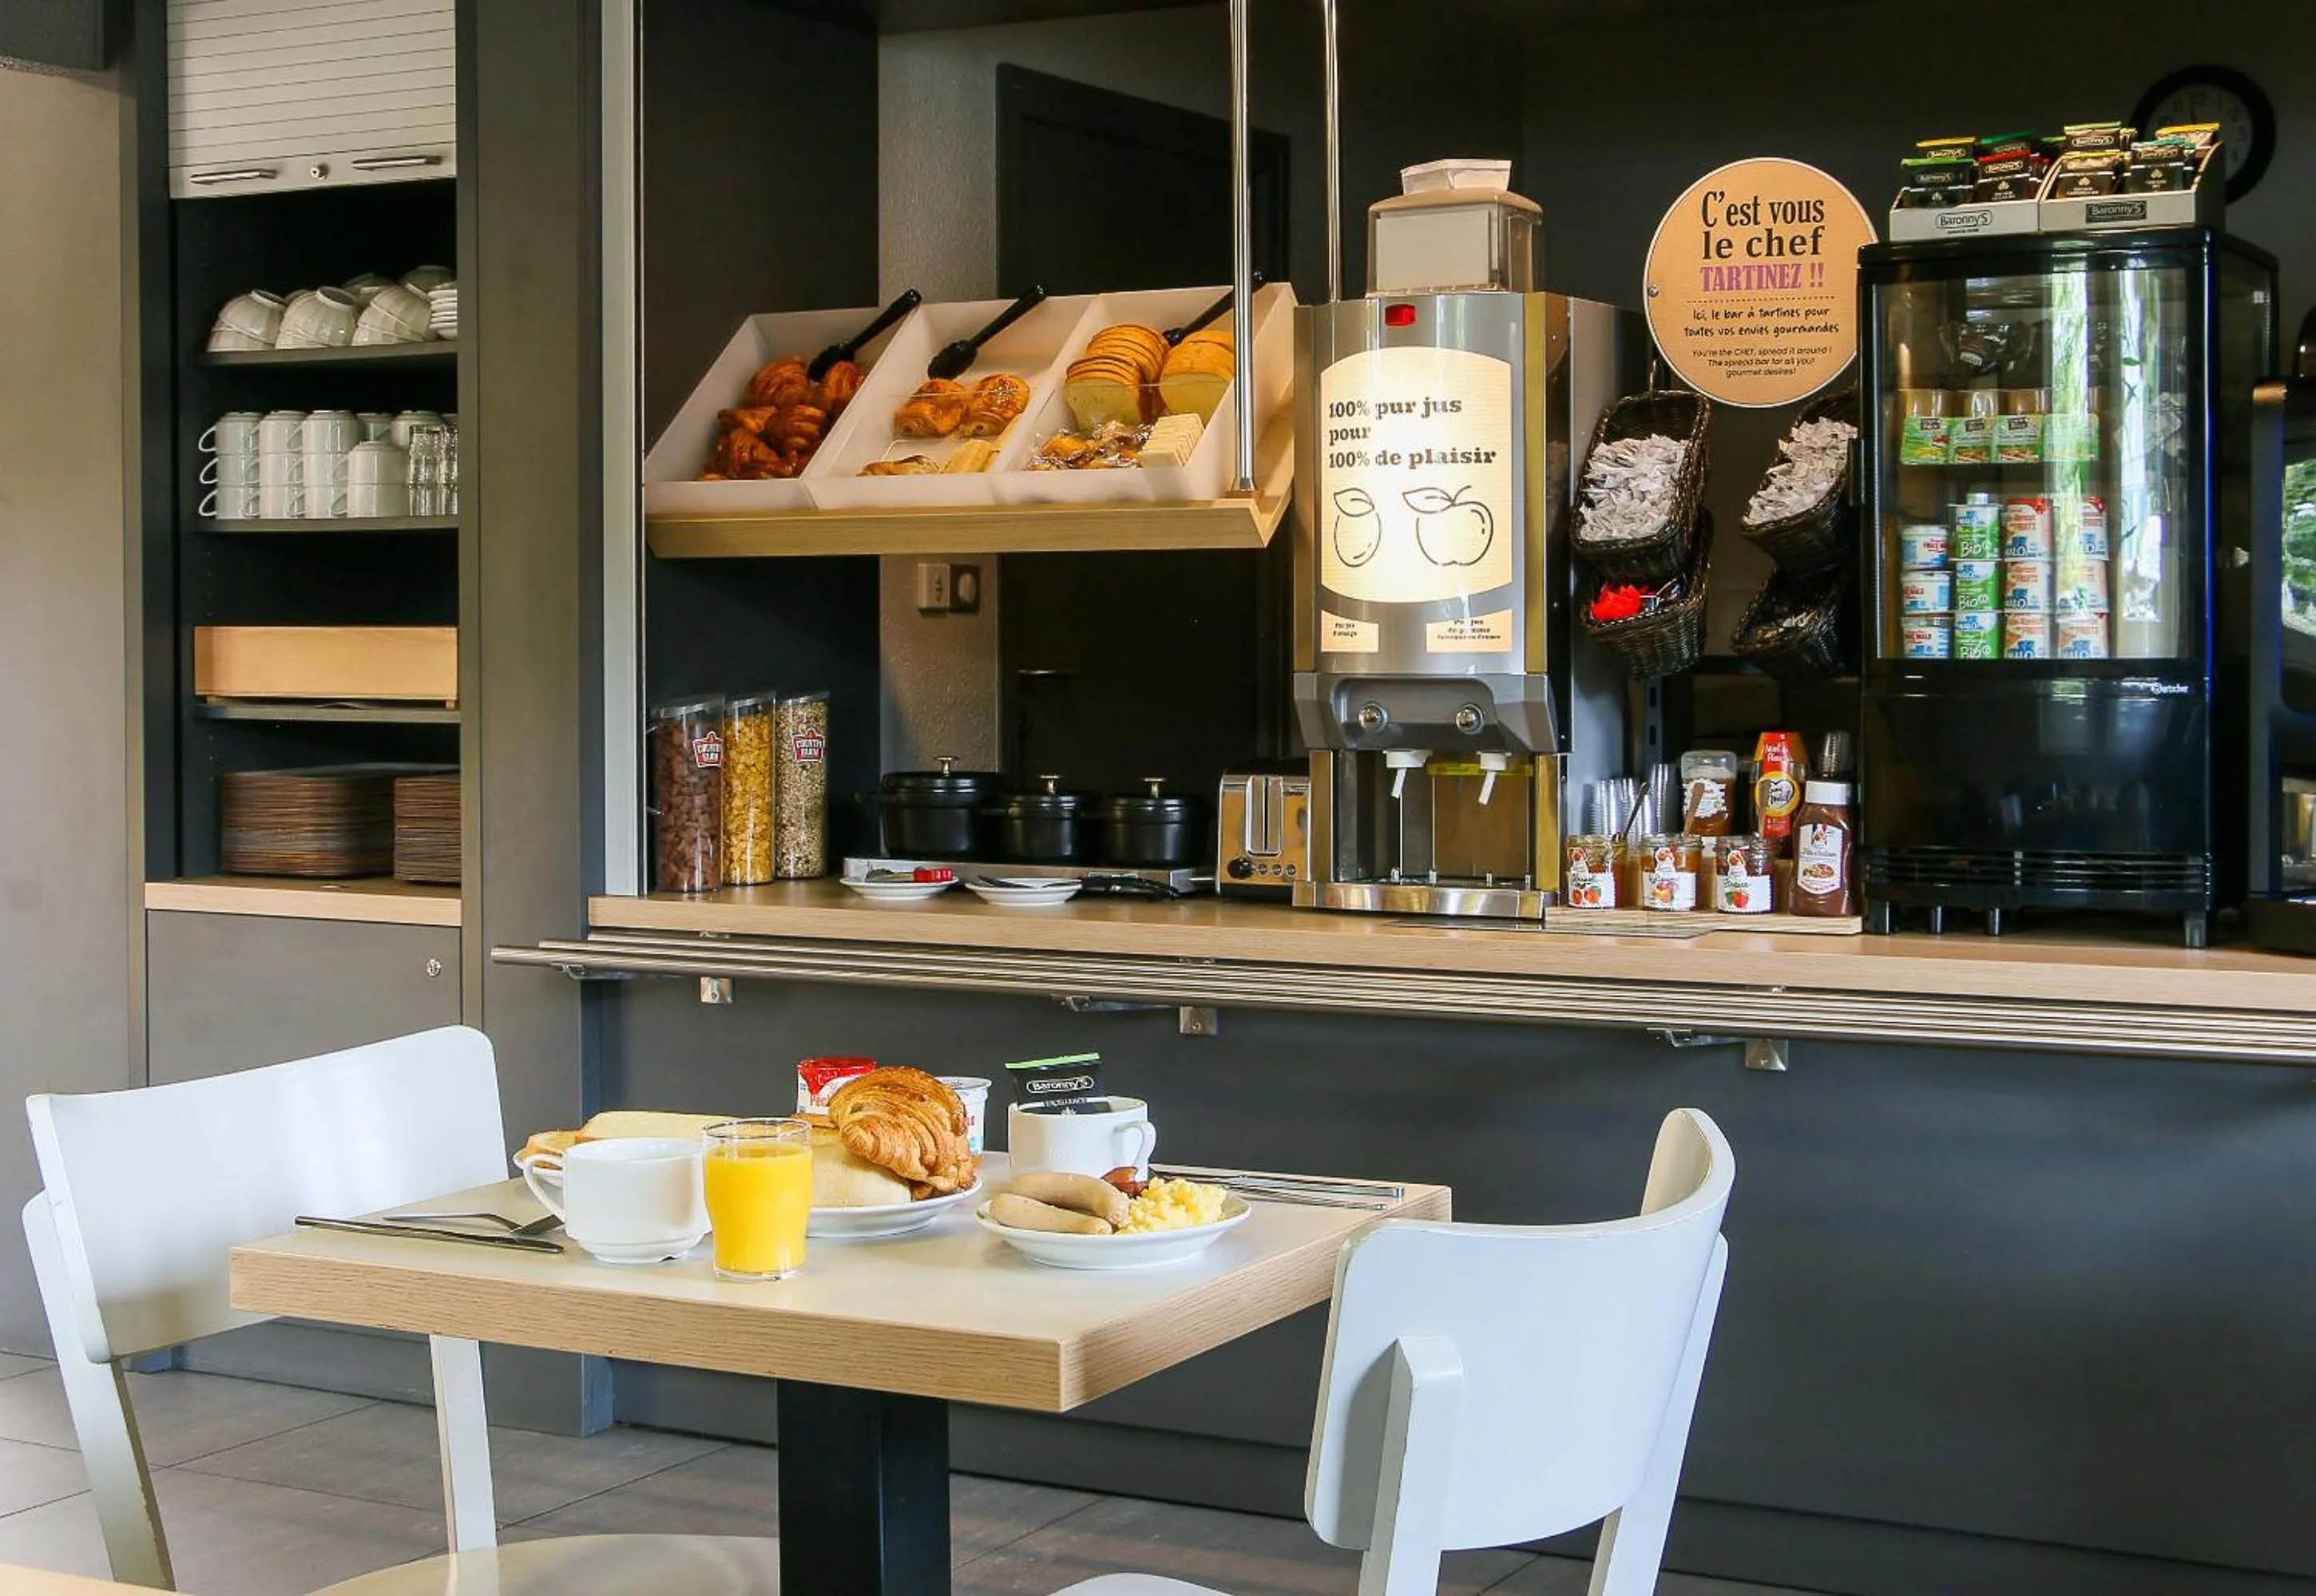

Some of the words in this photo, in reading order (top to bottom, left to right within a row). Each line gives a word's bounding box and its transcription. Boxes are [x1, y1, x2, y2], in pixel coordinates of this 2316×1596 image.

[1702, 191, 1760, 228] C'est
[1769, 200, 1824, 224] vous
[1703, 231, 1733, 259] le
[1746, 225, 1825, 258] chef
[1699, 263, 1802, 292] TARTINEZ
[1810, 263, 1824, 287] !!
[1711, 310, 1719, 320] le
[1724, 310, 1743, 319] bar
[1759, 307, 1800, 318] tartines
[1804, 307, 1830, 320] pour
[1683, 326, 1715, 337] toutes
[1718, 327, 1735, 336] vos
[1739, 326, 1769, 335] envies
[1774, 322, 1840, 338] gourmandes
[1329, 400, 1370, 418] 100%
[1375, 401, 1417, 420] pur
[1421, 397, 1463, 418] jus
[1329, 426, 1371, 446] pour
[1329, 450, 1370, 469] 100%
[1375, 450, 1402, 466] de
[1409, 447, 1497, 469] plaisir
